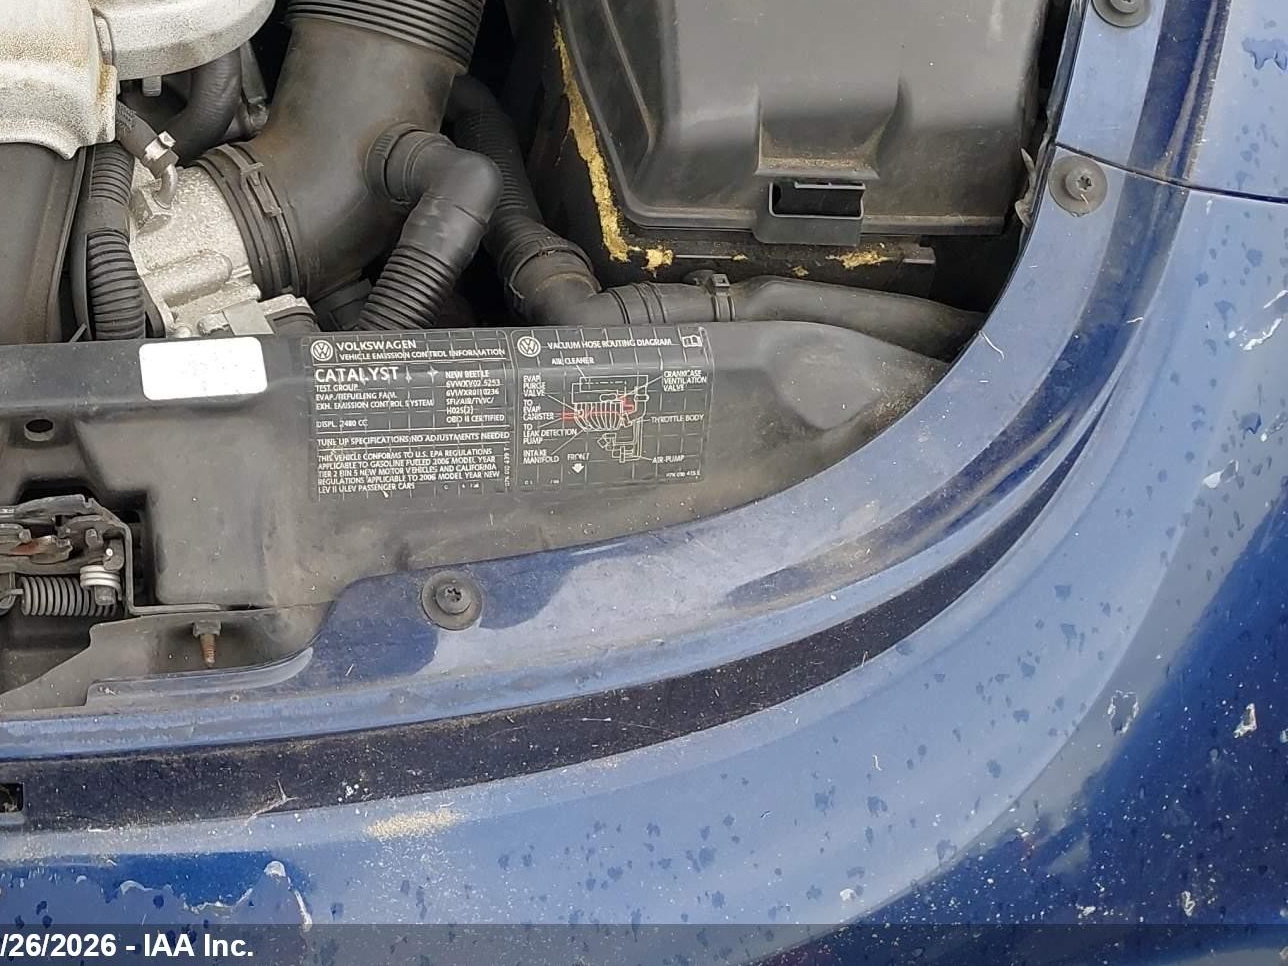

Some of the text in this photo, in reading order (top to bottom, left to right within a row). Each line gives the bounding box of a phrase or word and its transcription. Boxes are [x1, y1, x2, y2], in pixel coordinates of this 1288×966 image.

[336, 339, 417, 351] VOLKSWAGEN
[547, 338, 672, 349] VACUUM HOSE ROUTING DIAGRAM
[339, 348, 506, 361] VEHICLE EMISSION CONTROL INFORMATION
[552, 356, 595, 365] AIR CLEANER
[315, 366, 399, 382] CATALYST
[445, 370, 490, 379] NEW BEETLE
[663, 370, 702, 378] CRANKCASE
[663, 376, 707, 384] VENTILATION
[315, 384, 359, 392] TEST GROUP
[523, 389, 545, 397] VALVE
[334, 401, 369, 409] EMISSION
[370, 400, 404, 408] CONTROL
[405, 398, 434, 407] SYSTEM
[471, 414, 505, 422] CERTIFIED
[523, 412, 554, 421] CANISTER
[651, 413, 705, 423] THROTTLE BODY
[541, 428, 577, 437] DETECTION
[317, 438, 337, 446] TUNE
[338, 437, 349, 445] UP
[425, 433, 479, 442] ADJUSTMENTS
[481, 432, 510, 440] NEEDED
[334, 453, 362, 461] VEHICLE
[363, 452, 402, 460] CONFORMS
[444, 448, 492, 457] REGULATIONS
[523, 449, 547, 457] INTAKE
[567, 452, 590, 461] FRONT
[523, 455, 560, 464] MANIFOLD
[317, 462, 359, 470] APPLICABLE
[370, 460, 404, 468] GASOLINE
[318, 470, 332, 478] TIER
[378, 467, 405, 475] MOTOR
[406, 466, 438, 474] VEHICLES
[455, 463, 497, 472] CALIFORNIA
[318, 477, 364, 485] REGULATIONS
[366, 475, 405, 484] APPLICABLE
[318, 485, 331, 494] LEV
[339, 484, 356, 492] ULEV
[358, 483, 396, 491] PASSENGER
[398, 482, 415, 490] CARS
